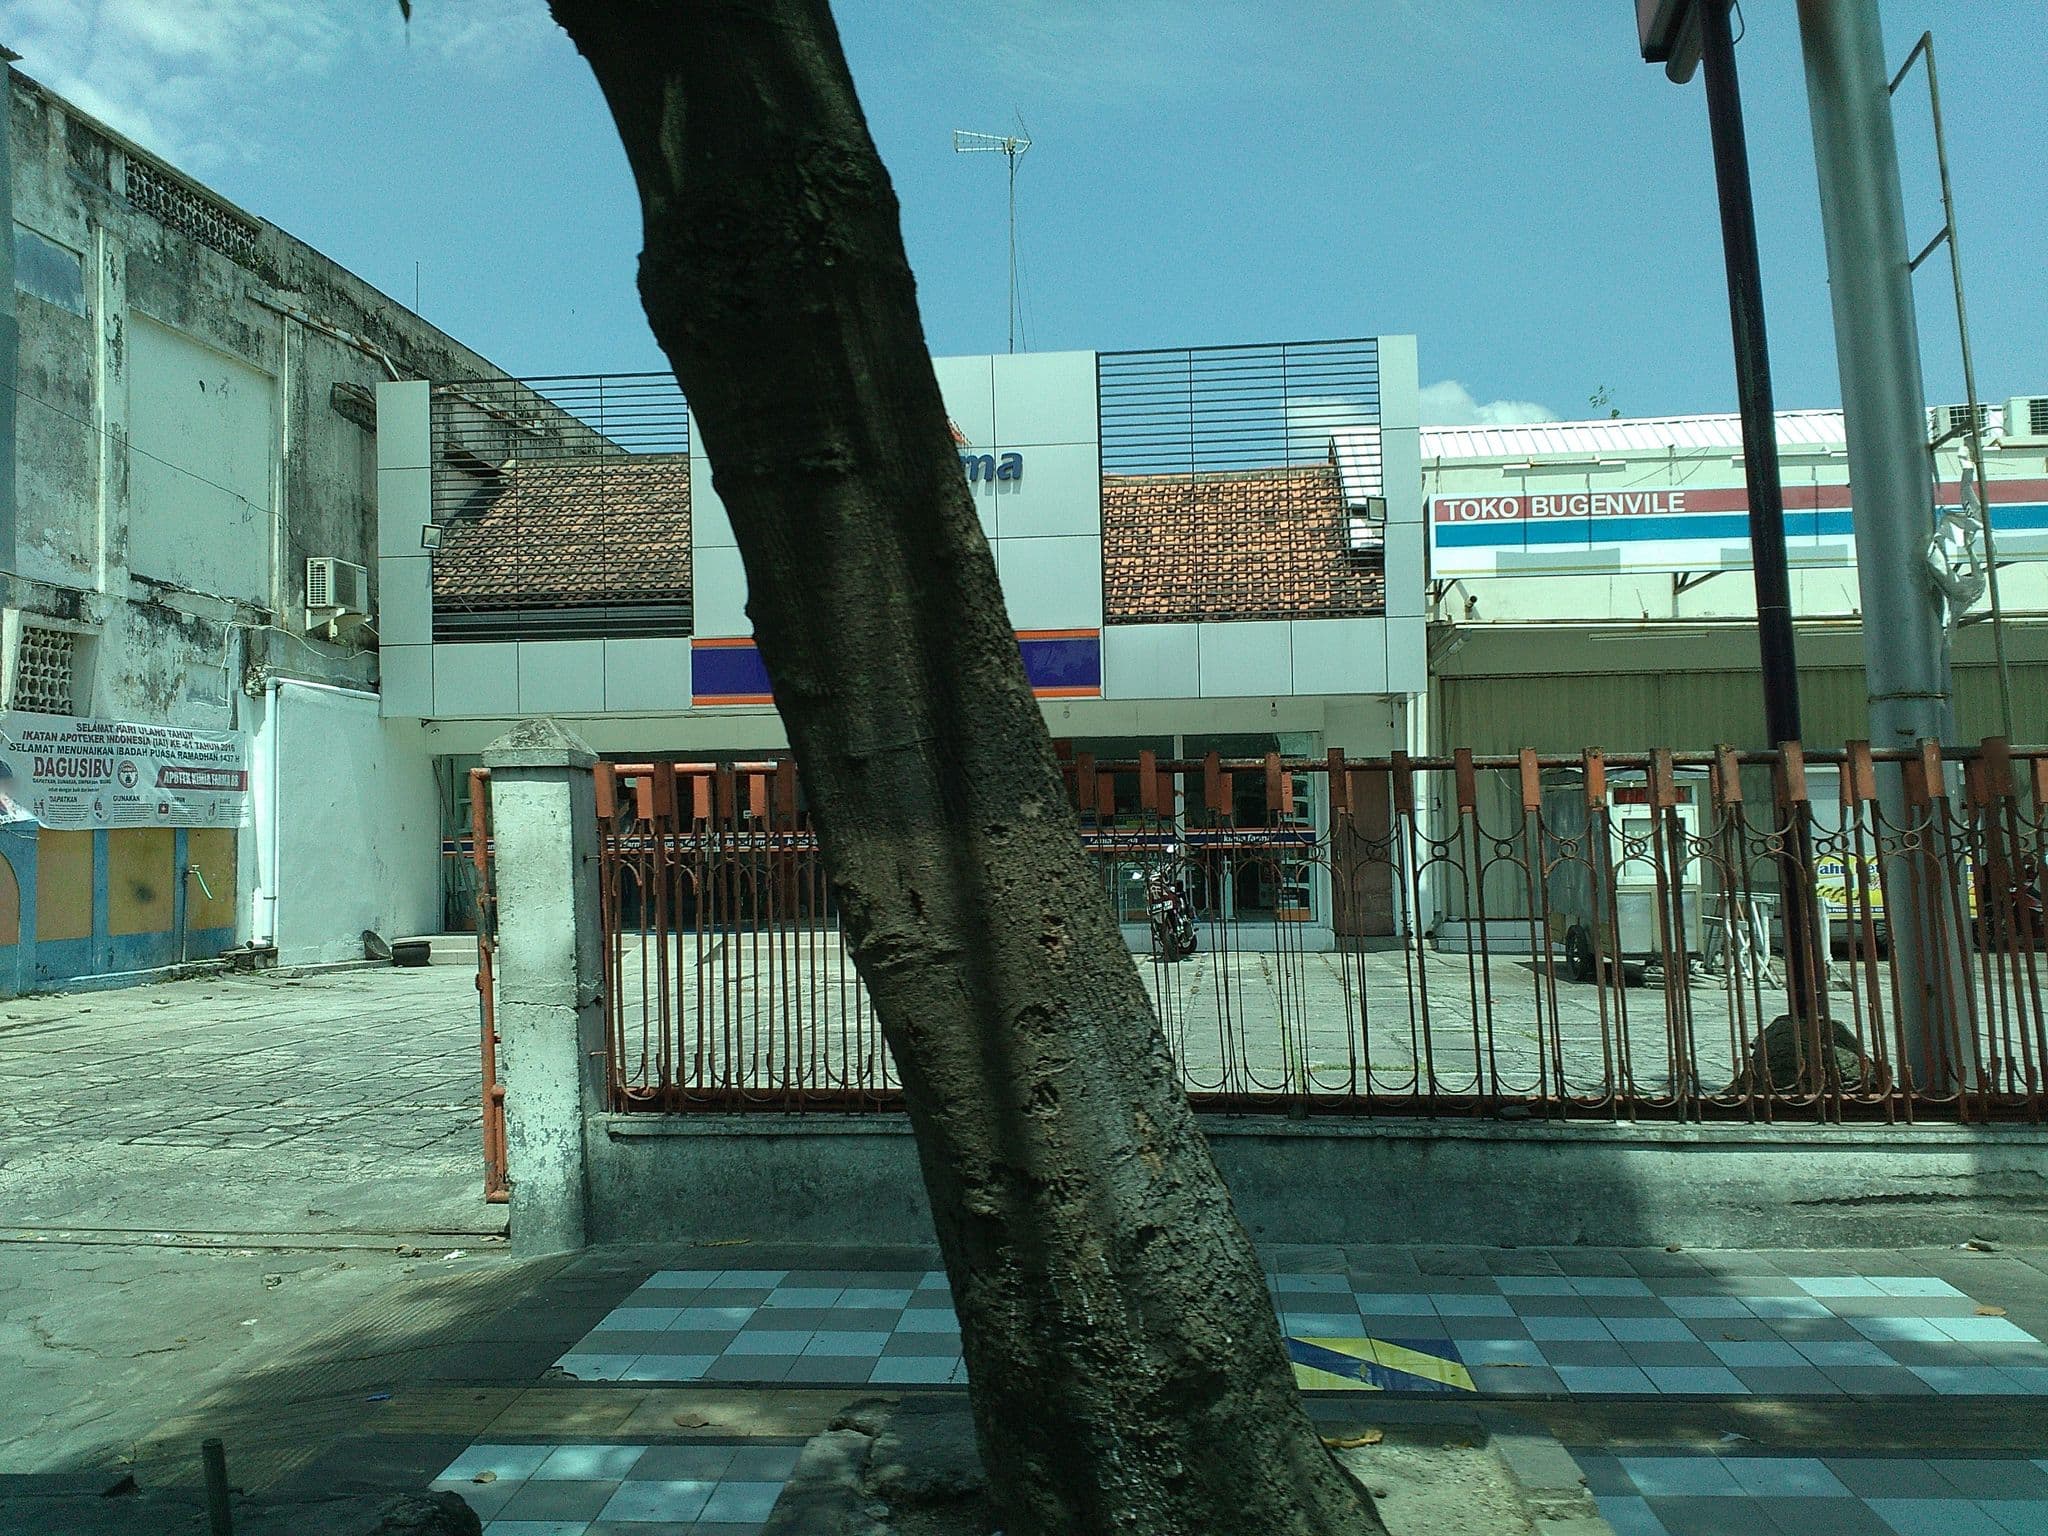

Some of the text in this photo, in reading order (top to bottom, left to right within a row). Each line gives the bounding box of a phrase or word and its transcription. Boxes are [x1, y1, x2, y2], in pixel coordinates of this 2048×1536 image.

[1443, 492, 1686, 521] TOKO BUGENVILE
[22, 730, 58, 741] IKATAN
[60, 733, 105, 744] APOTEKER
[106, 735, 152, 745] INDONESIA
[195, 742, 219, 751] TAHUN
[76, 722, 194, 740] SELAMAT HARI ULANG TAHUN
[9, 743, 54, 754] SELAMAT
[57, 745, 114, 756] MENUNAIKAN
[116, 747, 148, 757] IBADAH
[150, 749, 176, 759] PUASA
[177, 751, 218, 761] RAMADHAN
[220, 754, 233, 763] 1437
[33, 756, 114, 778] DAGUSIBU
[163, 770, 192, 785] APOTEK
